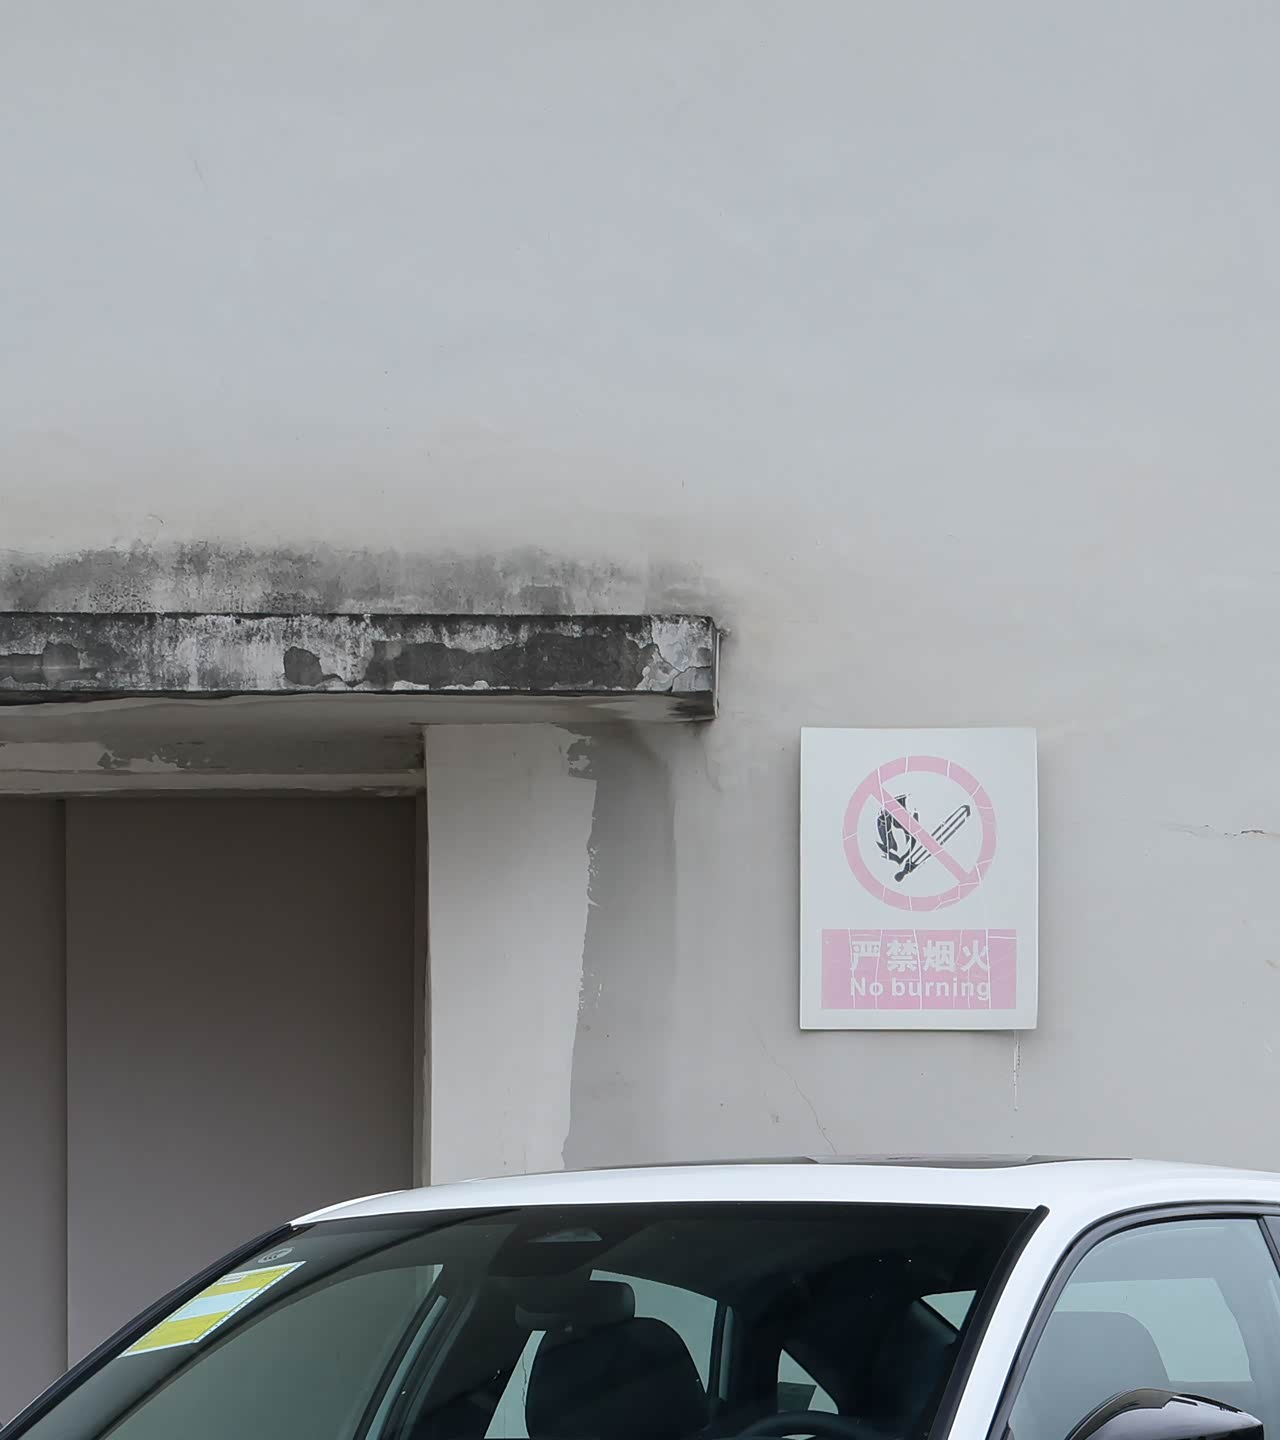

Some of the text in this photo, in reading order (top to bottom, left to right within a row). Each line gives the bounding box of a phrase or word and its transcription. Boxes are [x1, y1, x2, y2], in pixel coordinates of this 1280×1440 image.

[850, 940, 990, 972] 严禁烟火
[850, 976, 991, 1001] No burning
